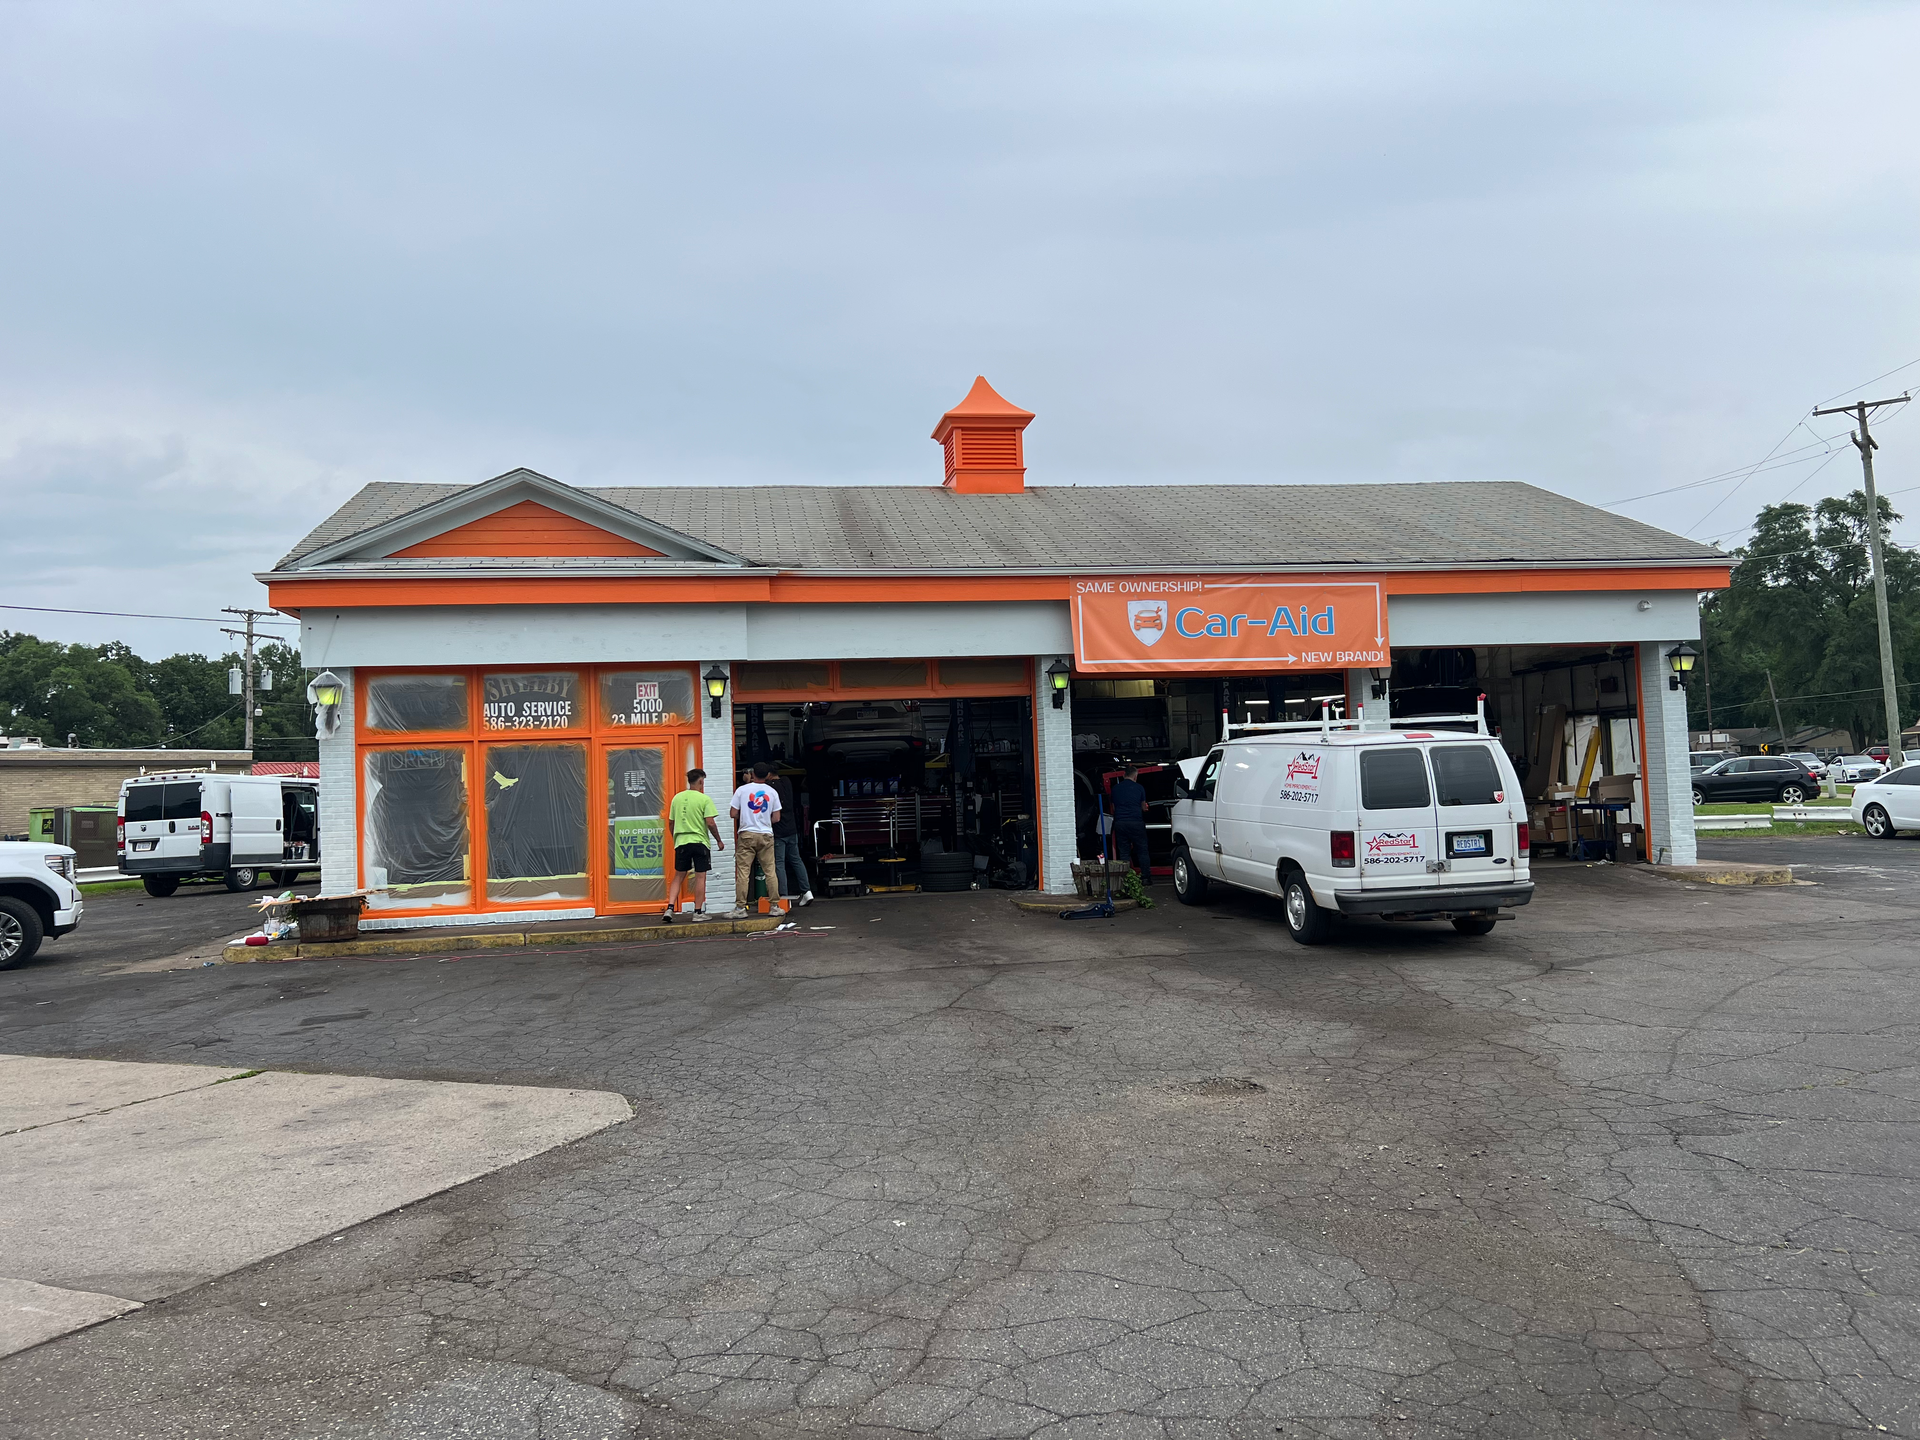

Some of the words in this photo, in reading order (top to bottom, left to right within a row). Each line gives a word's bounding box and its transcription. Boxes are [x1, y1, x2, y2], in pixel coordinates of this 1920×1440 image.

[1076, 581, 1115, 594] SAME
[1118, 580, 1203, 593] OWNERSHIP!
[1174, 605, 1336, 639] Car-Aid
[1301, 651, 1334, 663] NEW
[1336, 650, 1385, 662] BRAND!
[485, 676, 574, 701] SHELBY
[637, 683, 658, 698] EXIT
[483, 702, 516, 717] AUTO
[522, 700, 572, 716] SERVICE
[633, 698, 663, 713] 5000
[483, 715, 569, 731] 586-323-2120
[611, 713, 626, 725] 23
[1280, 789, 1319, 803] 586-202-5717
[632, 827, 664, 835] CREDIT?
[619, 836, 638, 845] WE
[641, 835, 663, 844] SAY
[619, 844, 663, 859] YES!
[1364, 855, 1426, 865] 586-202-5717
